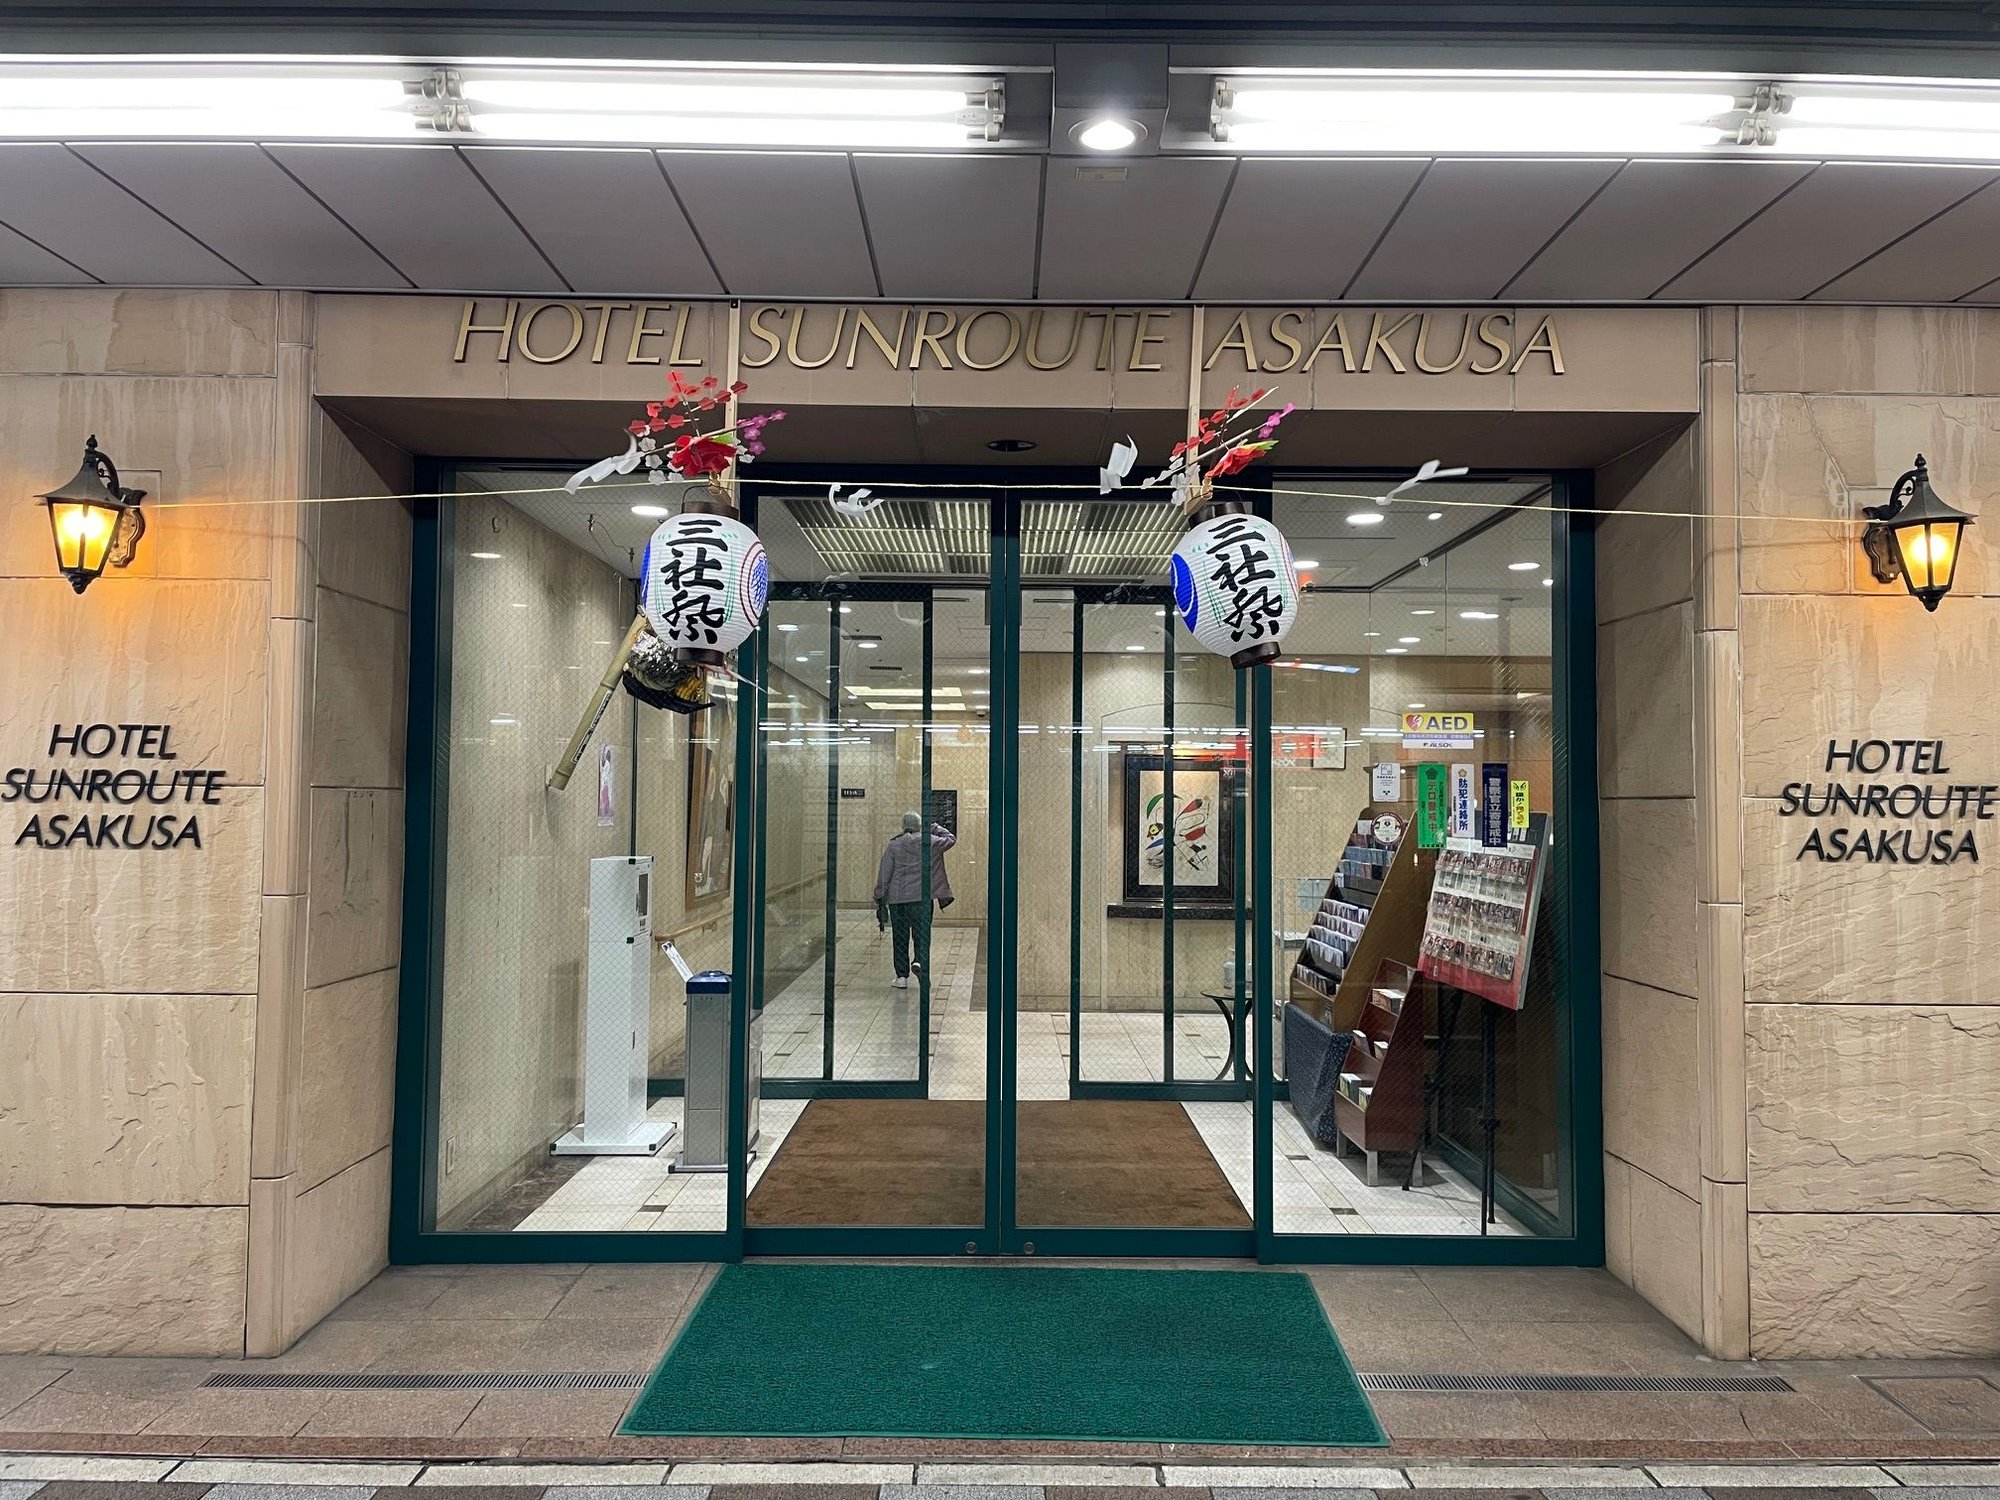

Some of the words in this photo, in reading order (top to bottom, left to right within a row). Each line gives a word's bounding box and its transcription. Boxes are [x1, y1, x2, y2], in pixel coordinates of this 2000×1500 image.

[453, 301, 704, 367] HOTEL
[741, 304, 1177, 373] SUNROUTE
[1203, 310, 1567, 376] ASAKUSA
[660, 518, 729, 645] 三社祭
[1205, 517, 1287, 643] 三社祭
[48, 723, 177, 760] HOTEL
[1426, 716, 1468, 731] AED
[1825, 739, 1950, 774] HOTEL
[1, 768, 227, 804] SUNROUTE
[1458, 778, 1468, 831] 防犯連絡所
[1778, 782, 1999, 819] SUNROUTE
[15, 813, 202, 849] ASAKUSA
[1796, 827, 1979, 864] ASAKUSA
